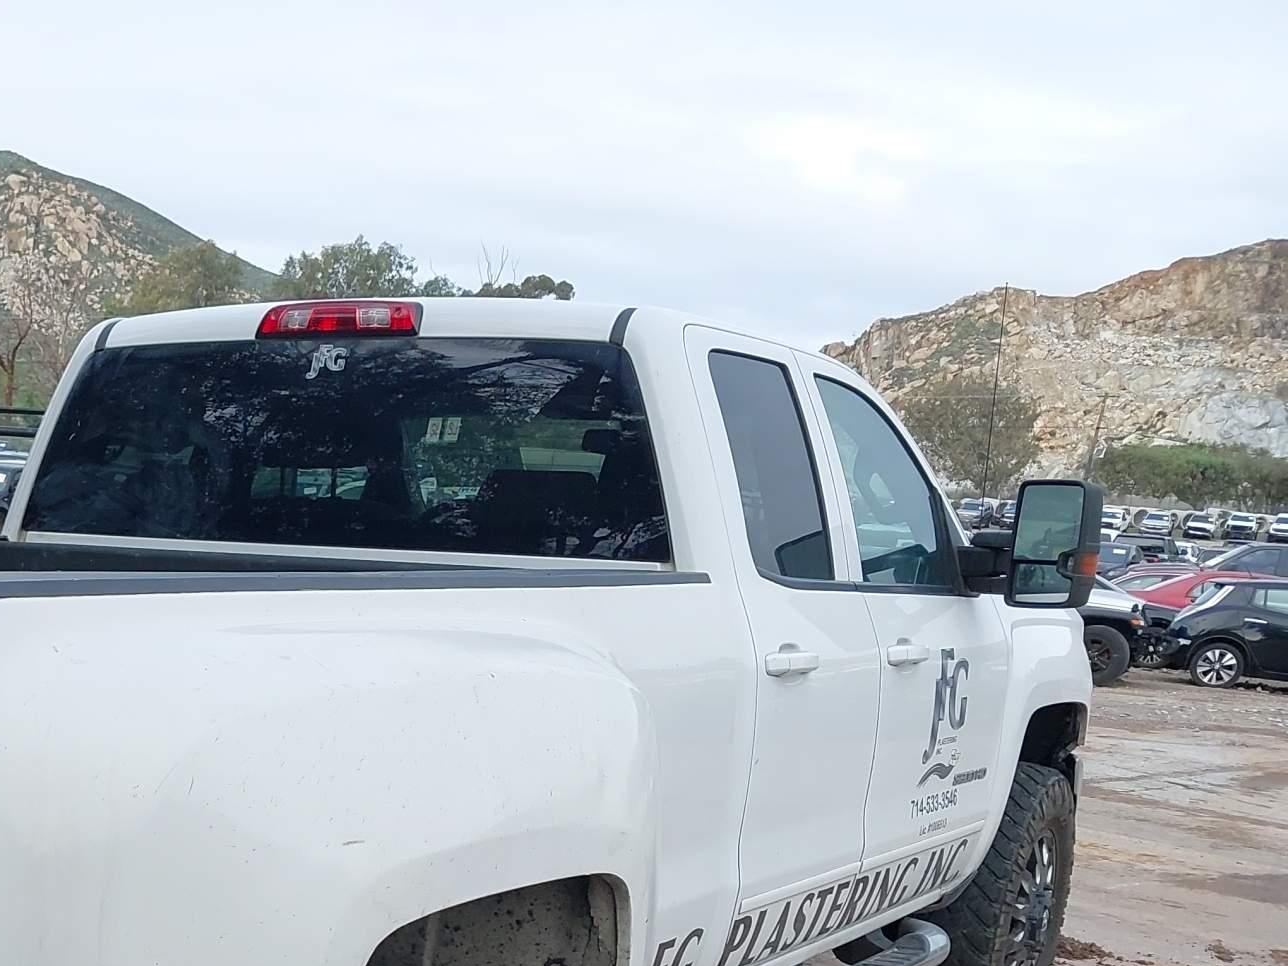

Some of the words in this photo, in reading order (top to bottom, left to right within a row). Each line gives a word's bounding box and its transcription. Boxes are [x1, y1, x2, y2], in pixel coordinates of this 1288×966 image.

[304, 344, 348, 380] JFG
[910, 788, 958, 819] 714-533-3546
[911, 838, 968, 898] INC
